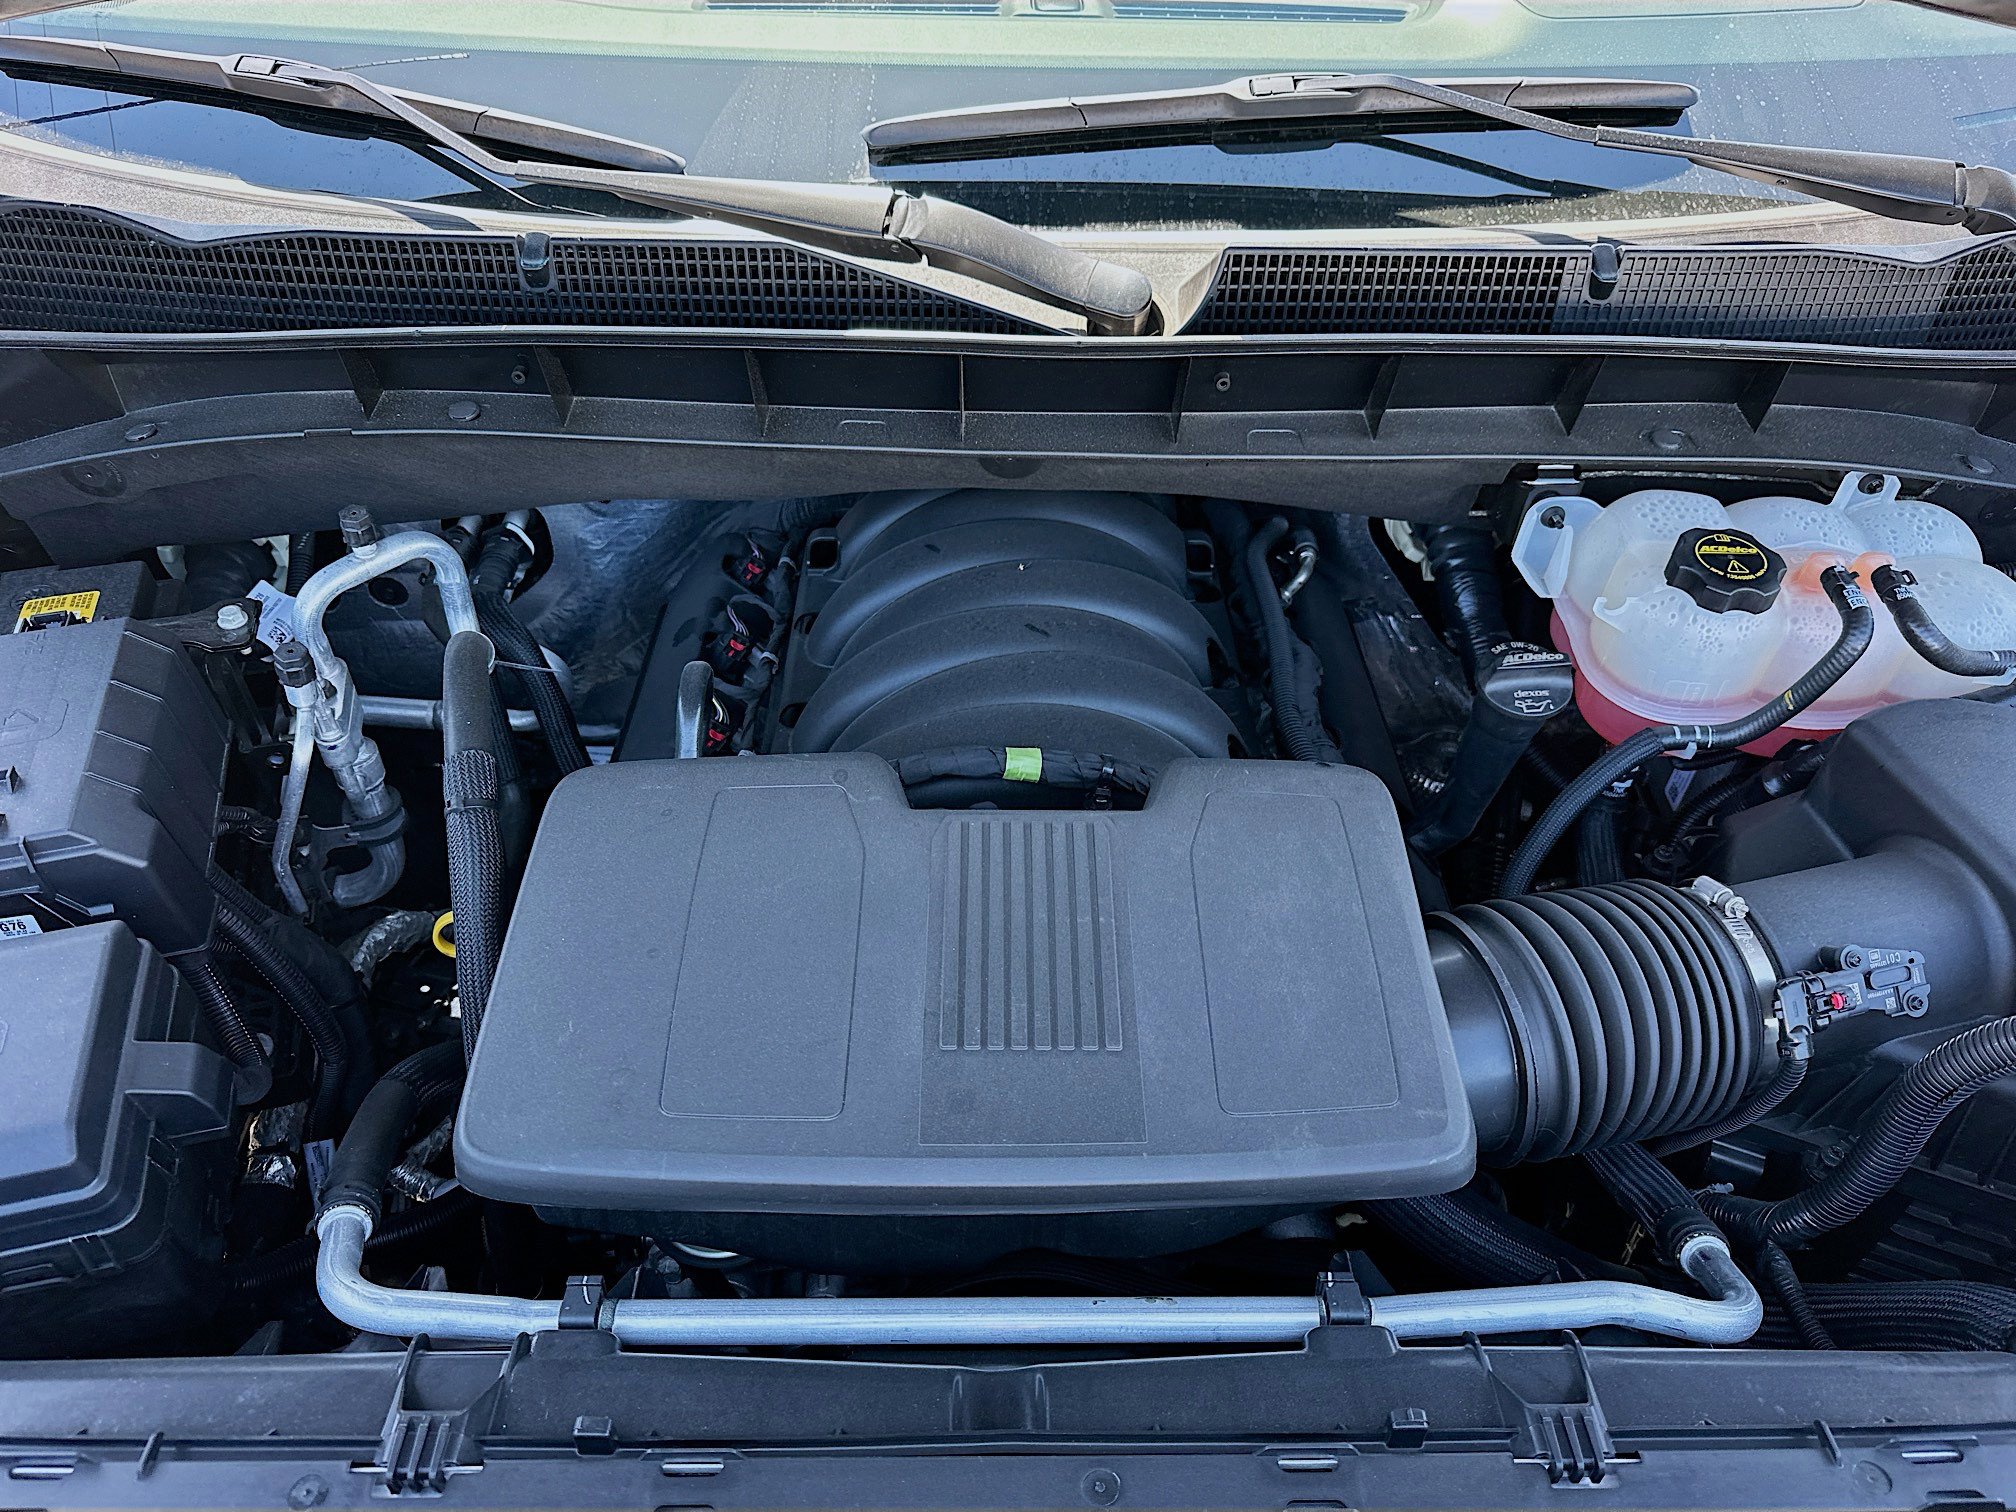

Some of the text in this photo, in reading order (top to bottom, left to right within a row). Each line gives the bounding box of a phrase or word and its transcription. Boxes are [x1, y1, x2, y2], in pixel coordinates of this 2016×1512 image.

[1699, 545, 1758, 554] ACDelco
[1491, 641, 1539, 655] SAE 0W-20
[1502, 651, 1564, 664] ACDelco
[1513, 689, 1550, 698] dexos
